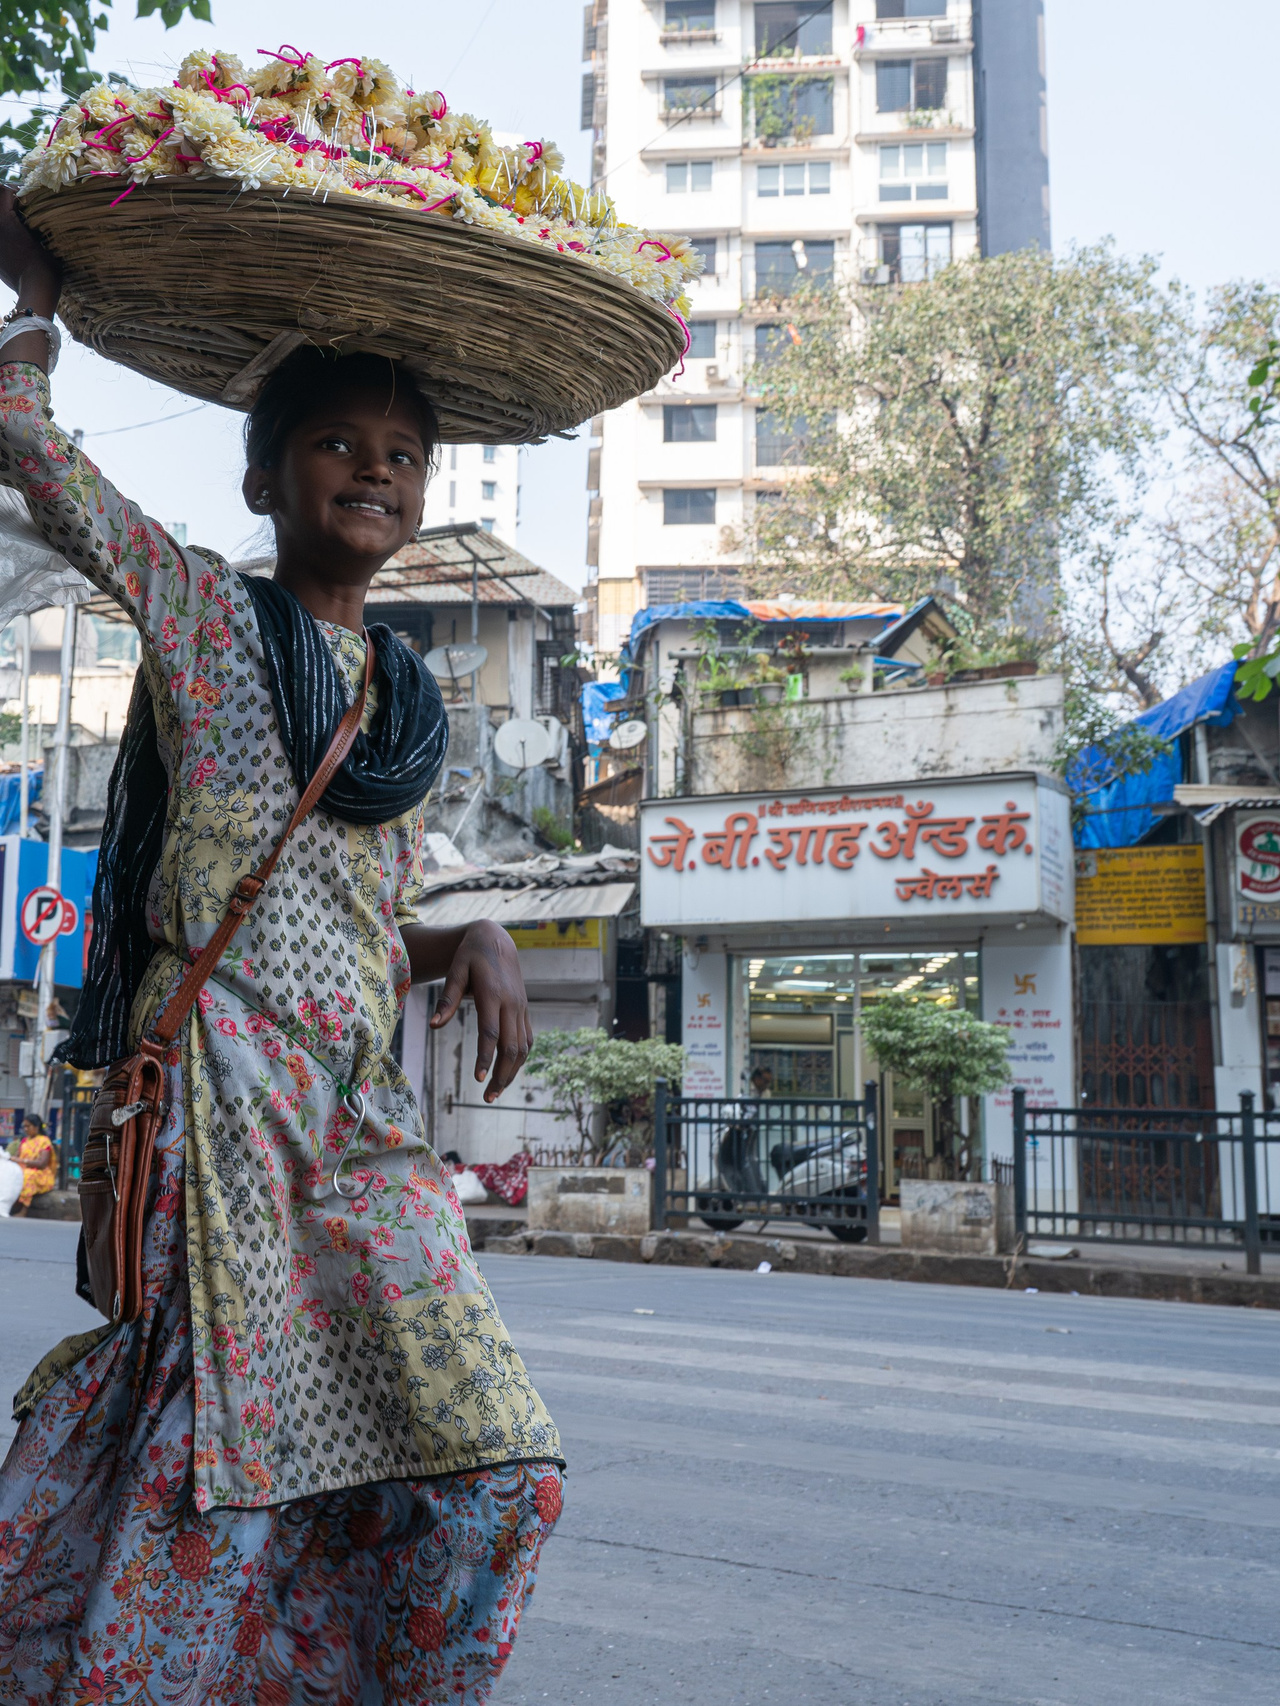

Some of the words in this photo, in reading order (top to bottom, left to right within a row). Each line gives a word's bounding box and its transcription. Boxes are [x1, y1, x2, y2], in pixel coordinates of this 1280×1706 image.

[647, 817, 696, 872] जे.
[701, 812, 760, 870] बी.
[764, 821, 868, 870] शाह
[977, 800, 1033, 856] कं.
[894, 864, 1000, 901] ज्वेलर्स
